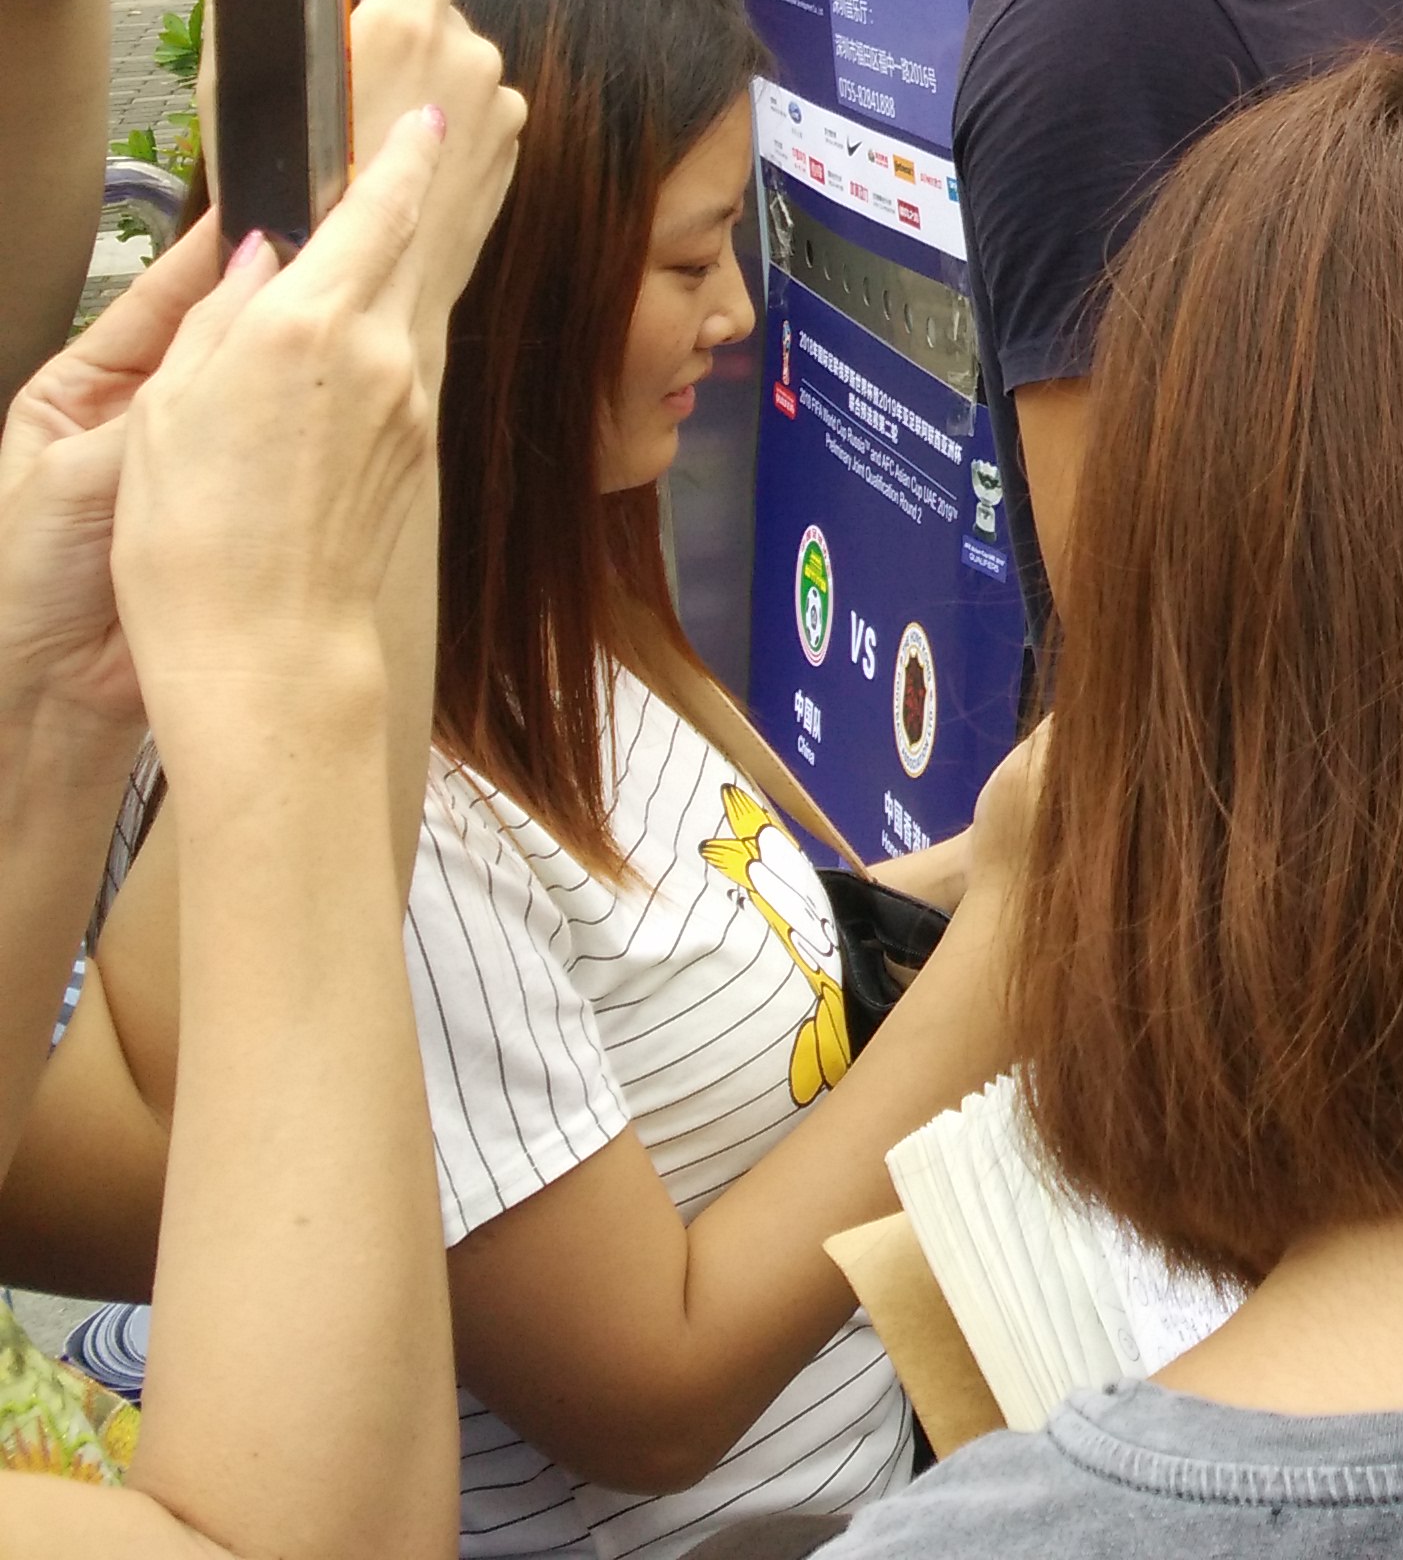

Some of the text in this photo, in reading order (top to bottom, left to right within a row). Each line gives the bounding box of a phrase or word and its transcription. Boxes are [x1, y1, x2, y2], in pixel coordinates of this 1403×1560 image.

[836, 417, 847, 441] Cup
[910, 475, 923, 500] Cup
[923, 485, 937, 510] UAE
[850, 609, 877, 680] VS
[794, 688, 822, 744] 中国队
[797, 734, 815, 767] China
